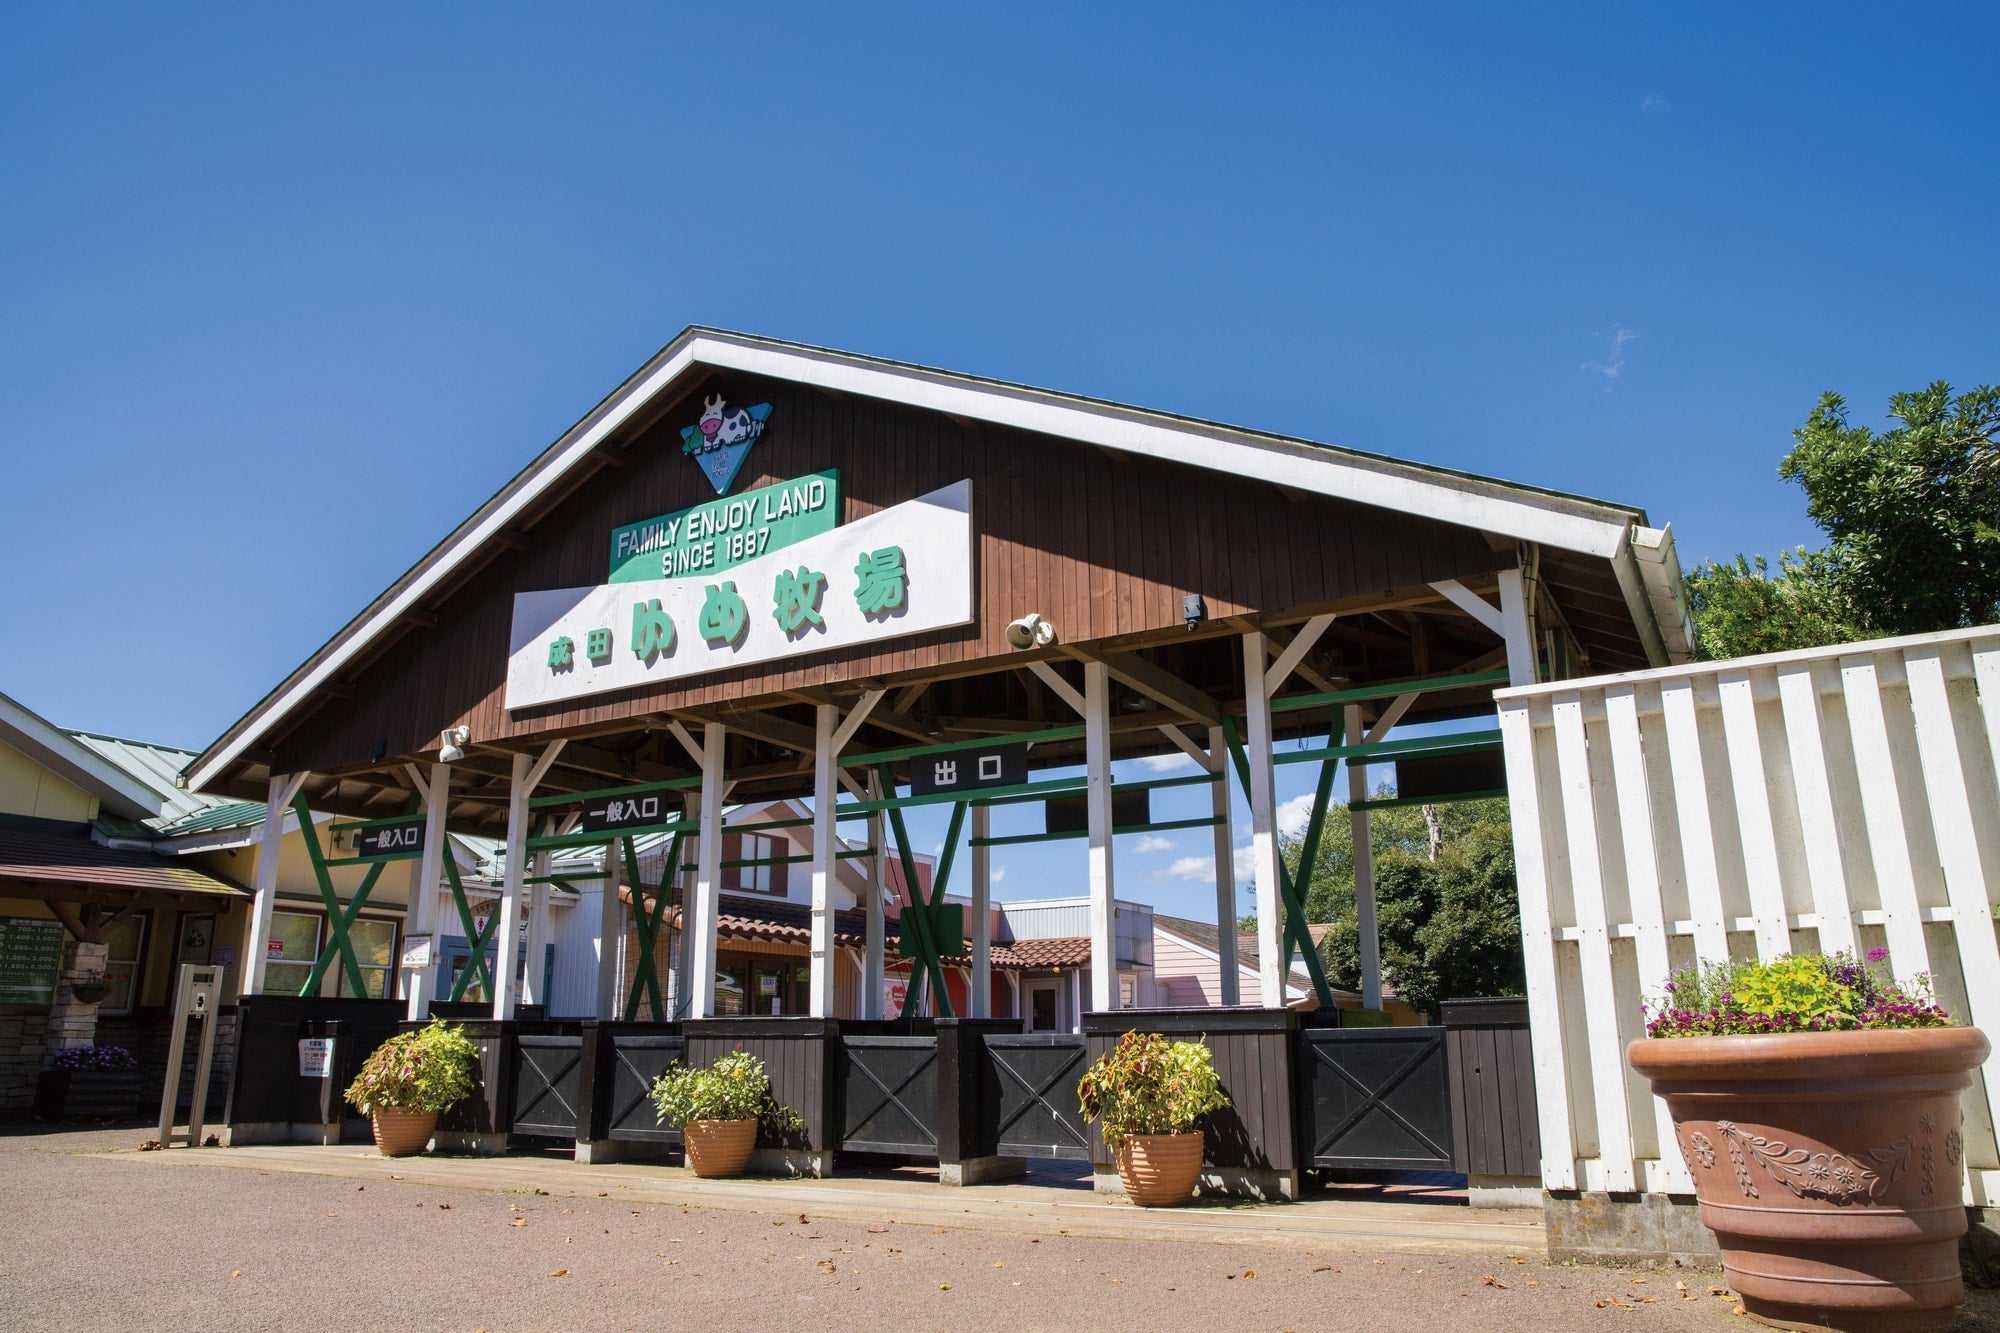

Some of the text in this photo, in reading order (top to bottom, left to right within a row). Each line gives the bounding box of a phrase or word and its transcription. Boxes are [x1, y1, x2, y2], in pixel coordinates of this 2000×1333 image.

[617, 479, 826, 559] FAMILY ENJOY LAND
[661, 527, 771, 576] SINCE 1887
[547, 545, 905, 668] 成田ゆめ牧場
[934, 755, 1002, 786] 出口
[589, 797, 659, 823] 一般入口
[365, 827, 418, 849] 一般入口
